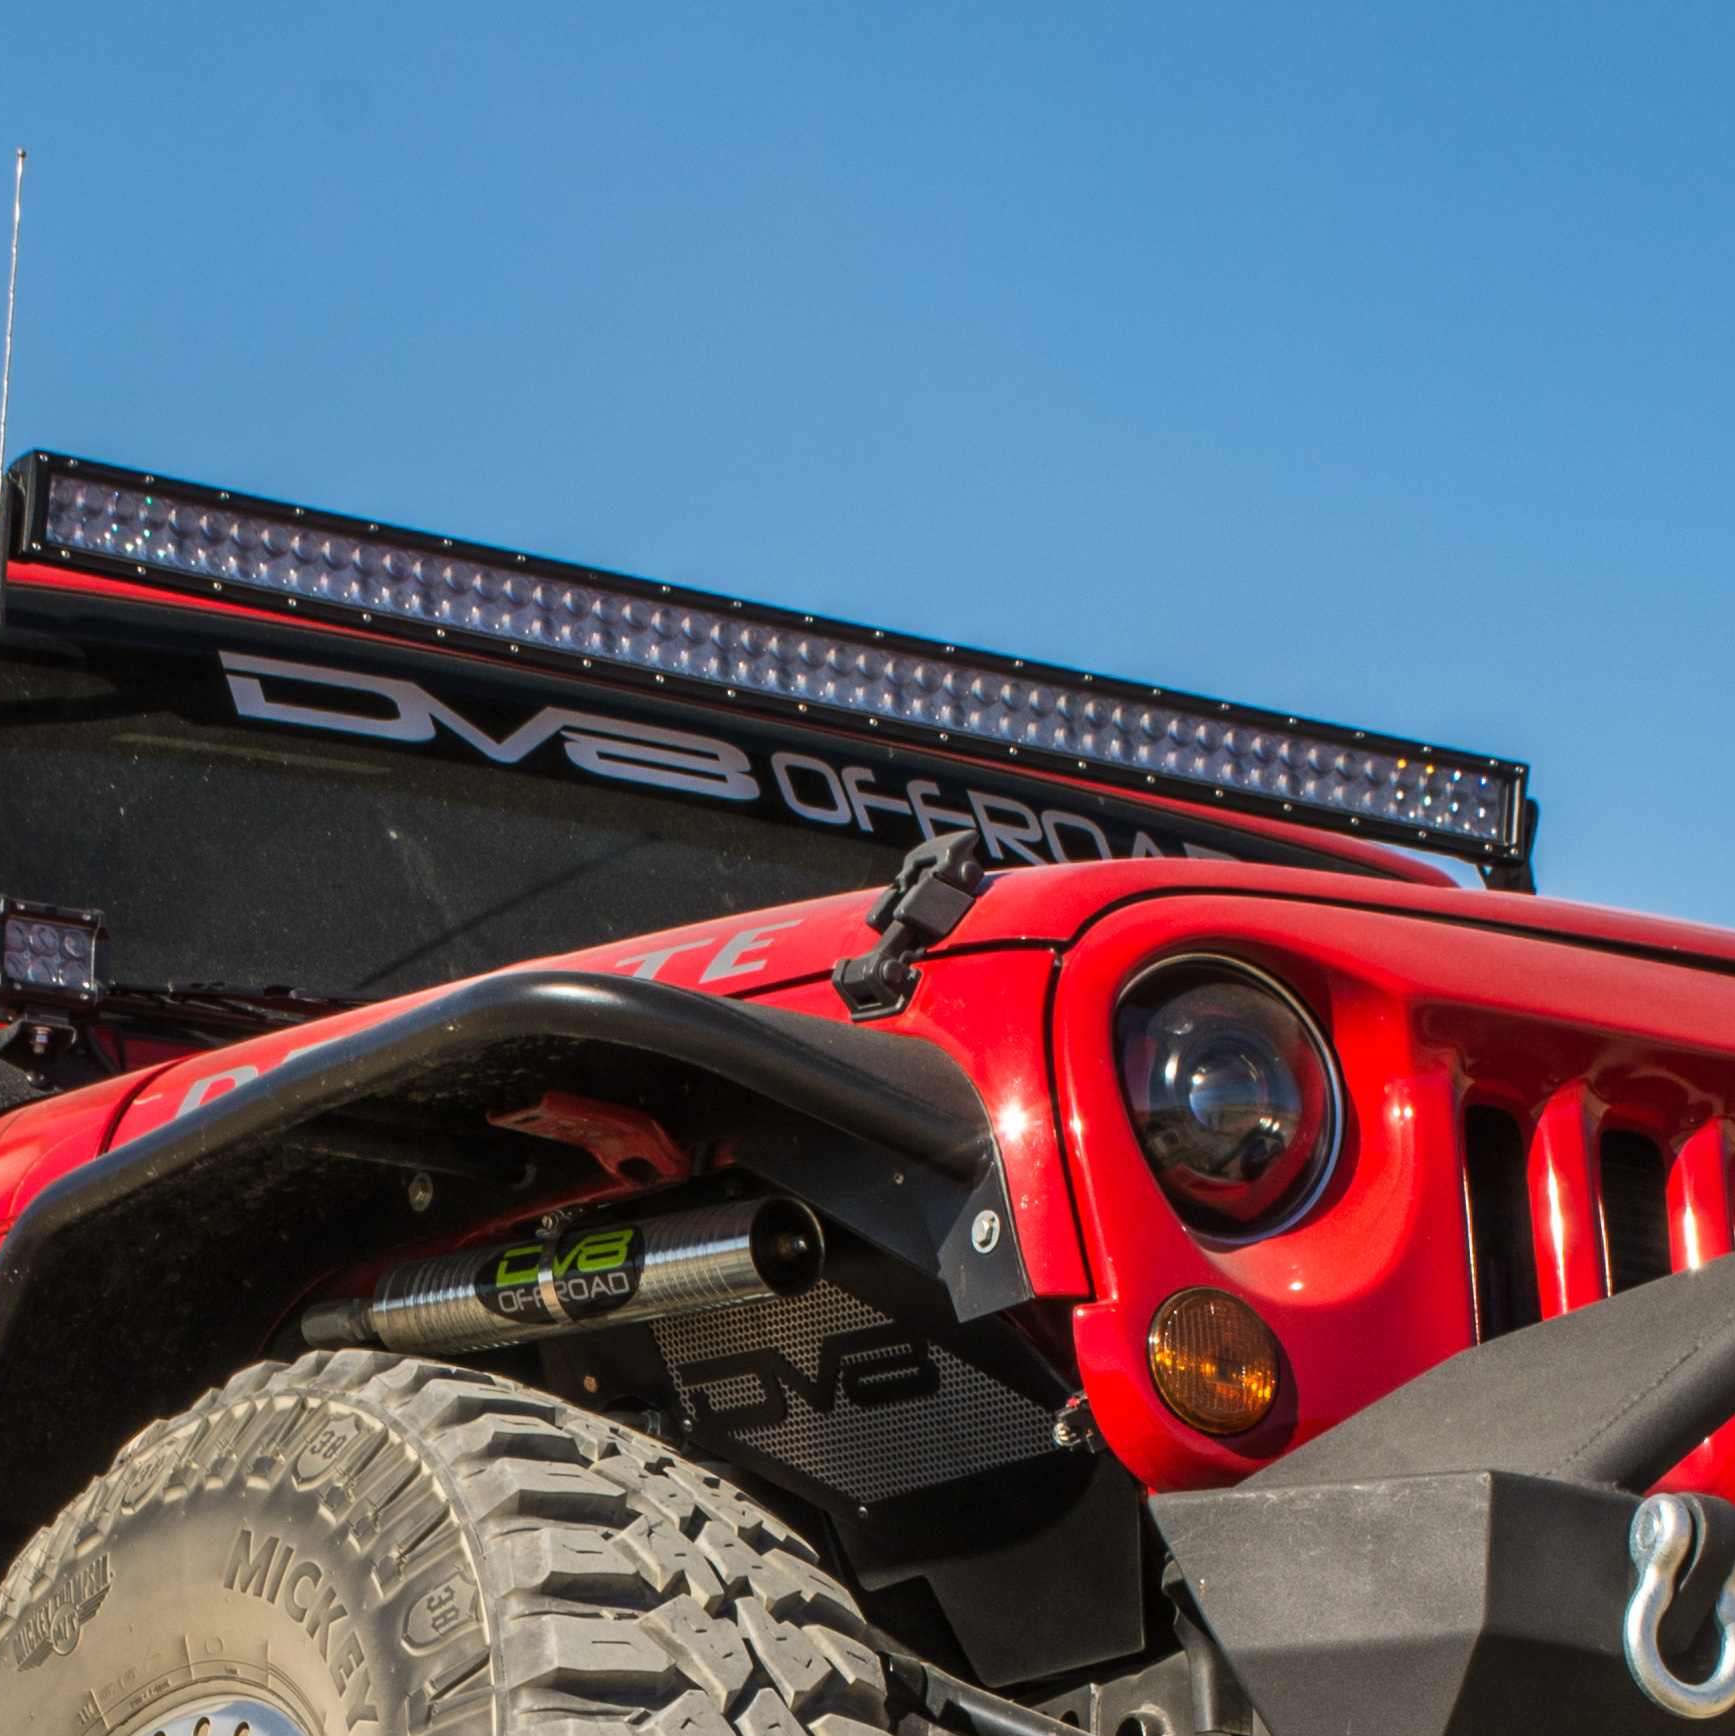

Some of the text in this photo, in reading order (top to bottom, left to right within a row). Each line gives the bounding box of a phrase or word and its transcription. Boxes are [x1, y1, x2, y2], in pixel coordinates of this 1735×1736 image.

[217, 650, 1242, 866] DV8 OFFRO
[496, 1228, 635, 1289] DV8
[675, 1320, 941, 1426] DV8
[223, 1529, 380, 1734] MICKEY
